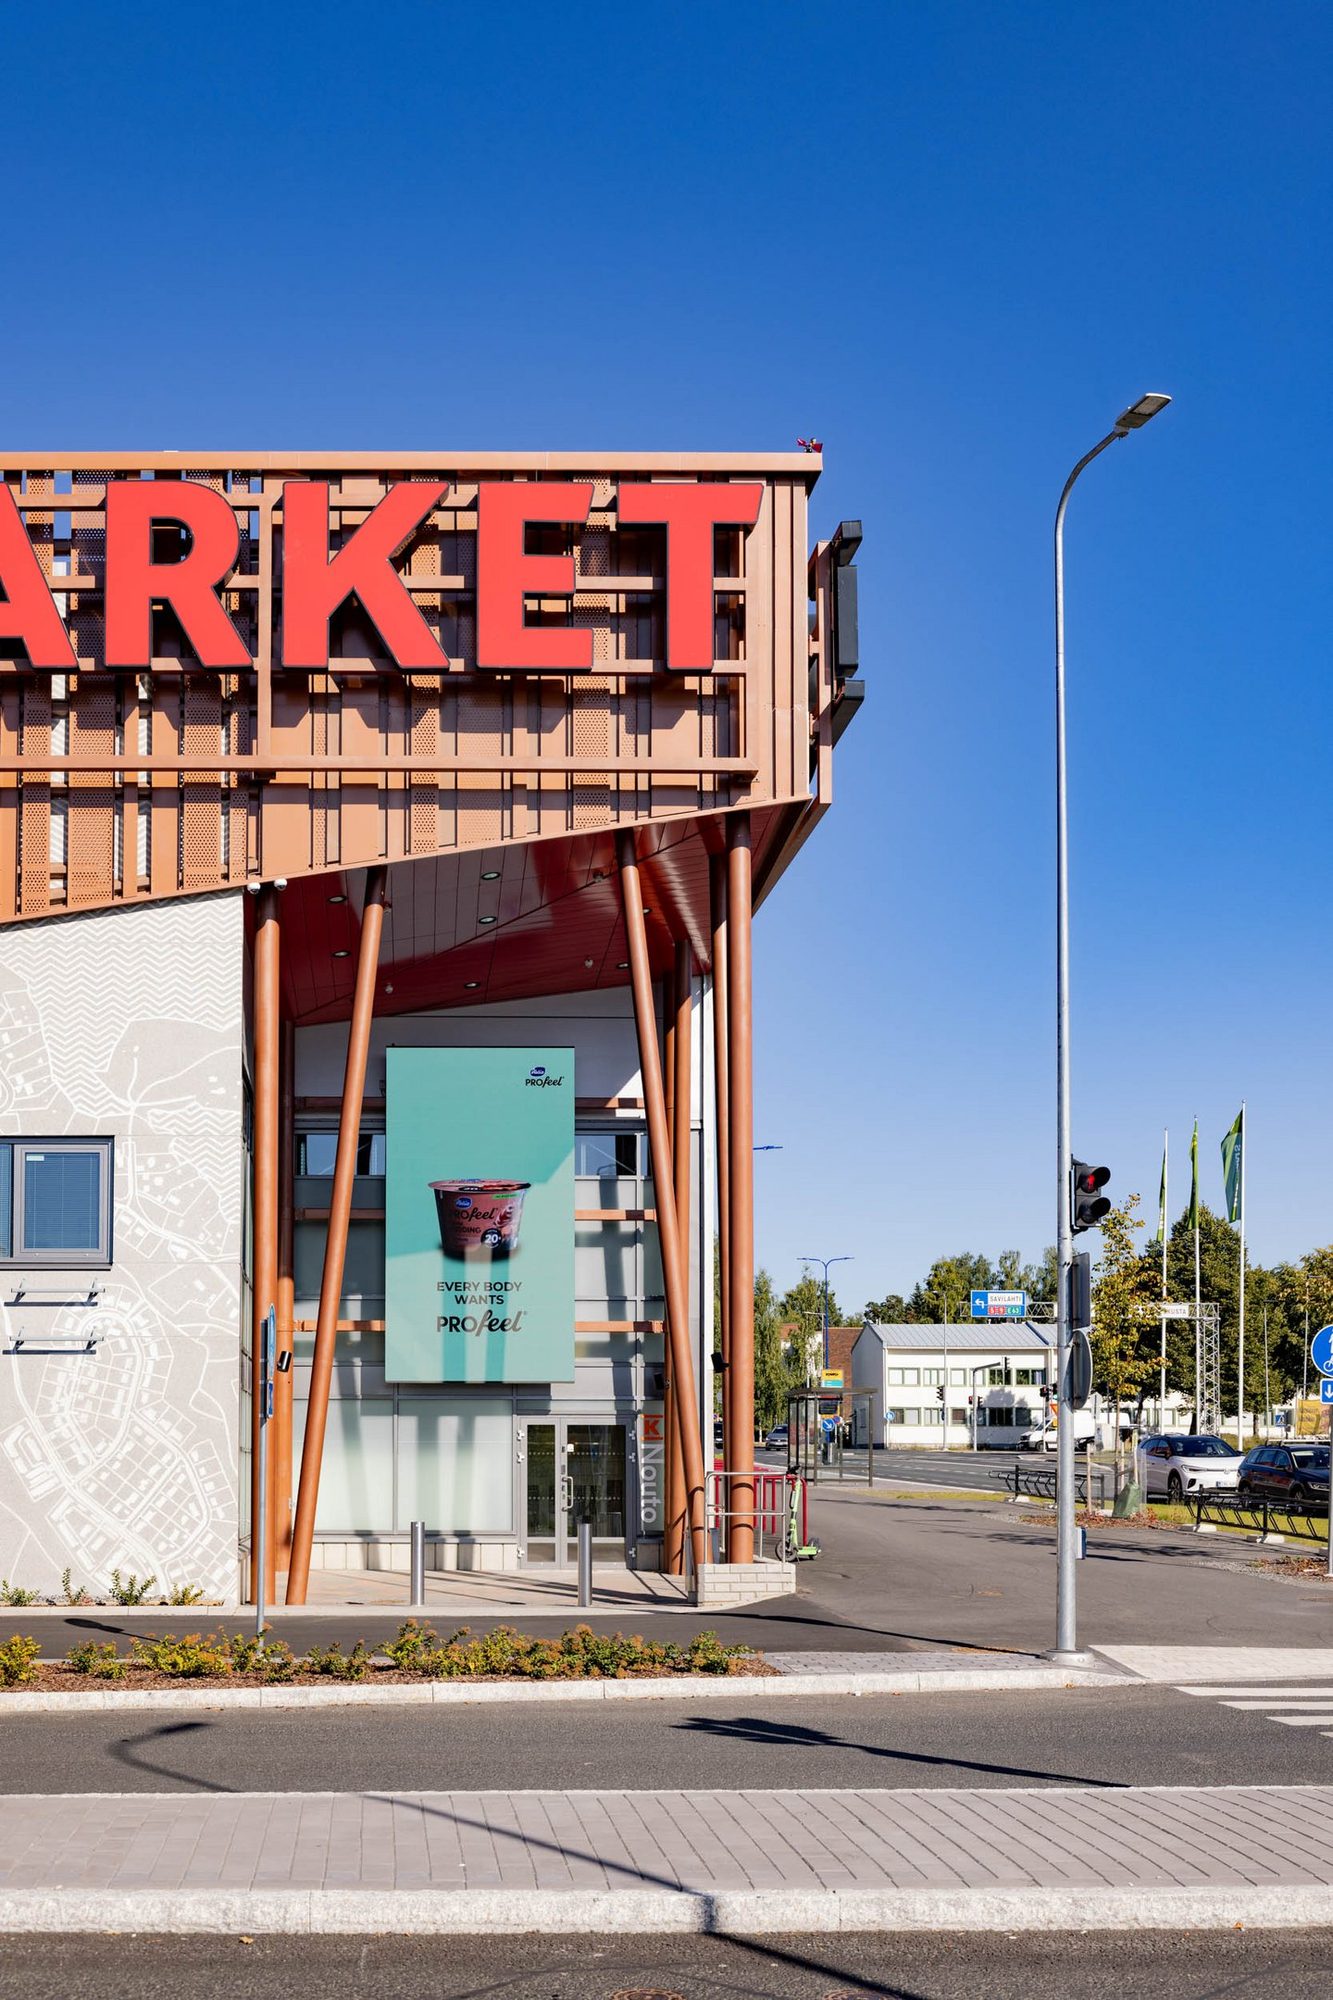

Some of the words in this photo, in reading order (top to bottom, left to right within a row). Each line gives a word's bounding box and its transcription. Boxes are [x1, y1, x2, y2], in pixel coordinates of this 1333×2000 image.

[525, 1076, 563, 1088] PROfeel
[437, 1281, 481, 1292] EVERY
[484, 1281, 522, 1292] BODY
[454, 1294, 505, 1305] WANTS
[436, 1309, 523, 1337] PROfeel
[643, 1418, 661, 1437] K
[640, 1443, 665, 1524] Nouto
